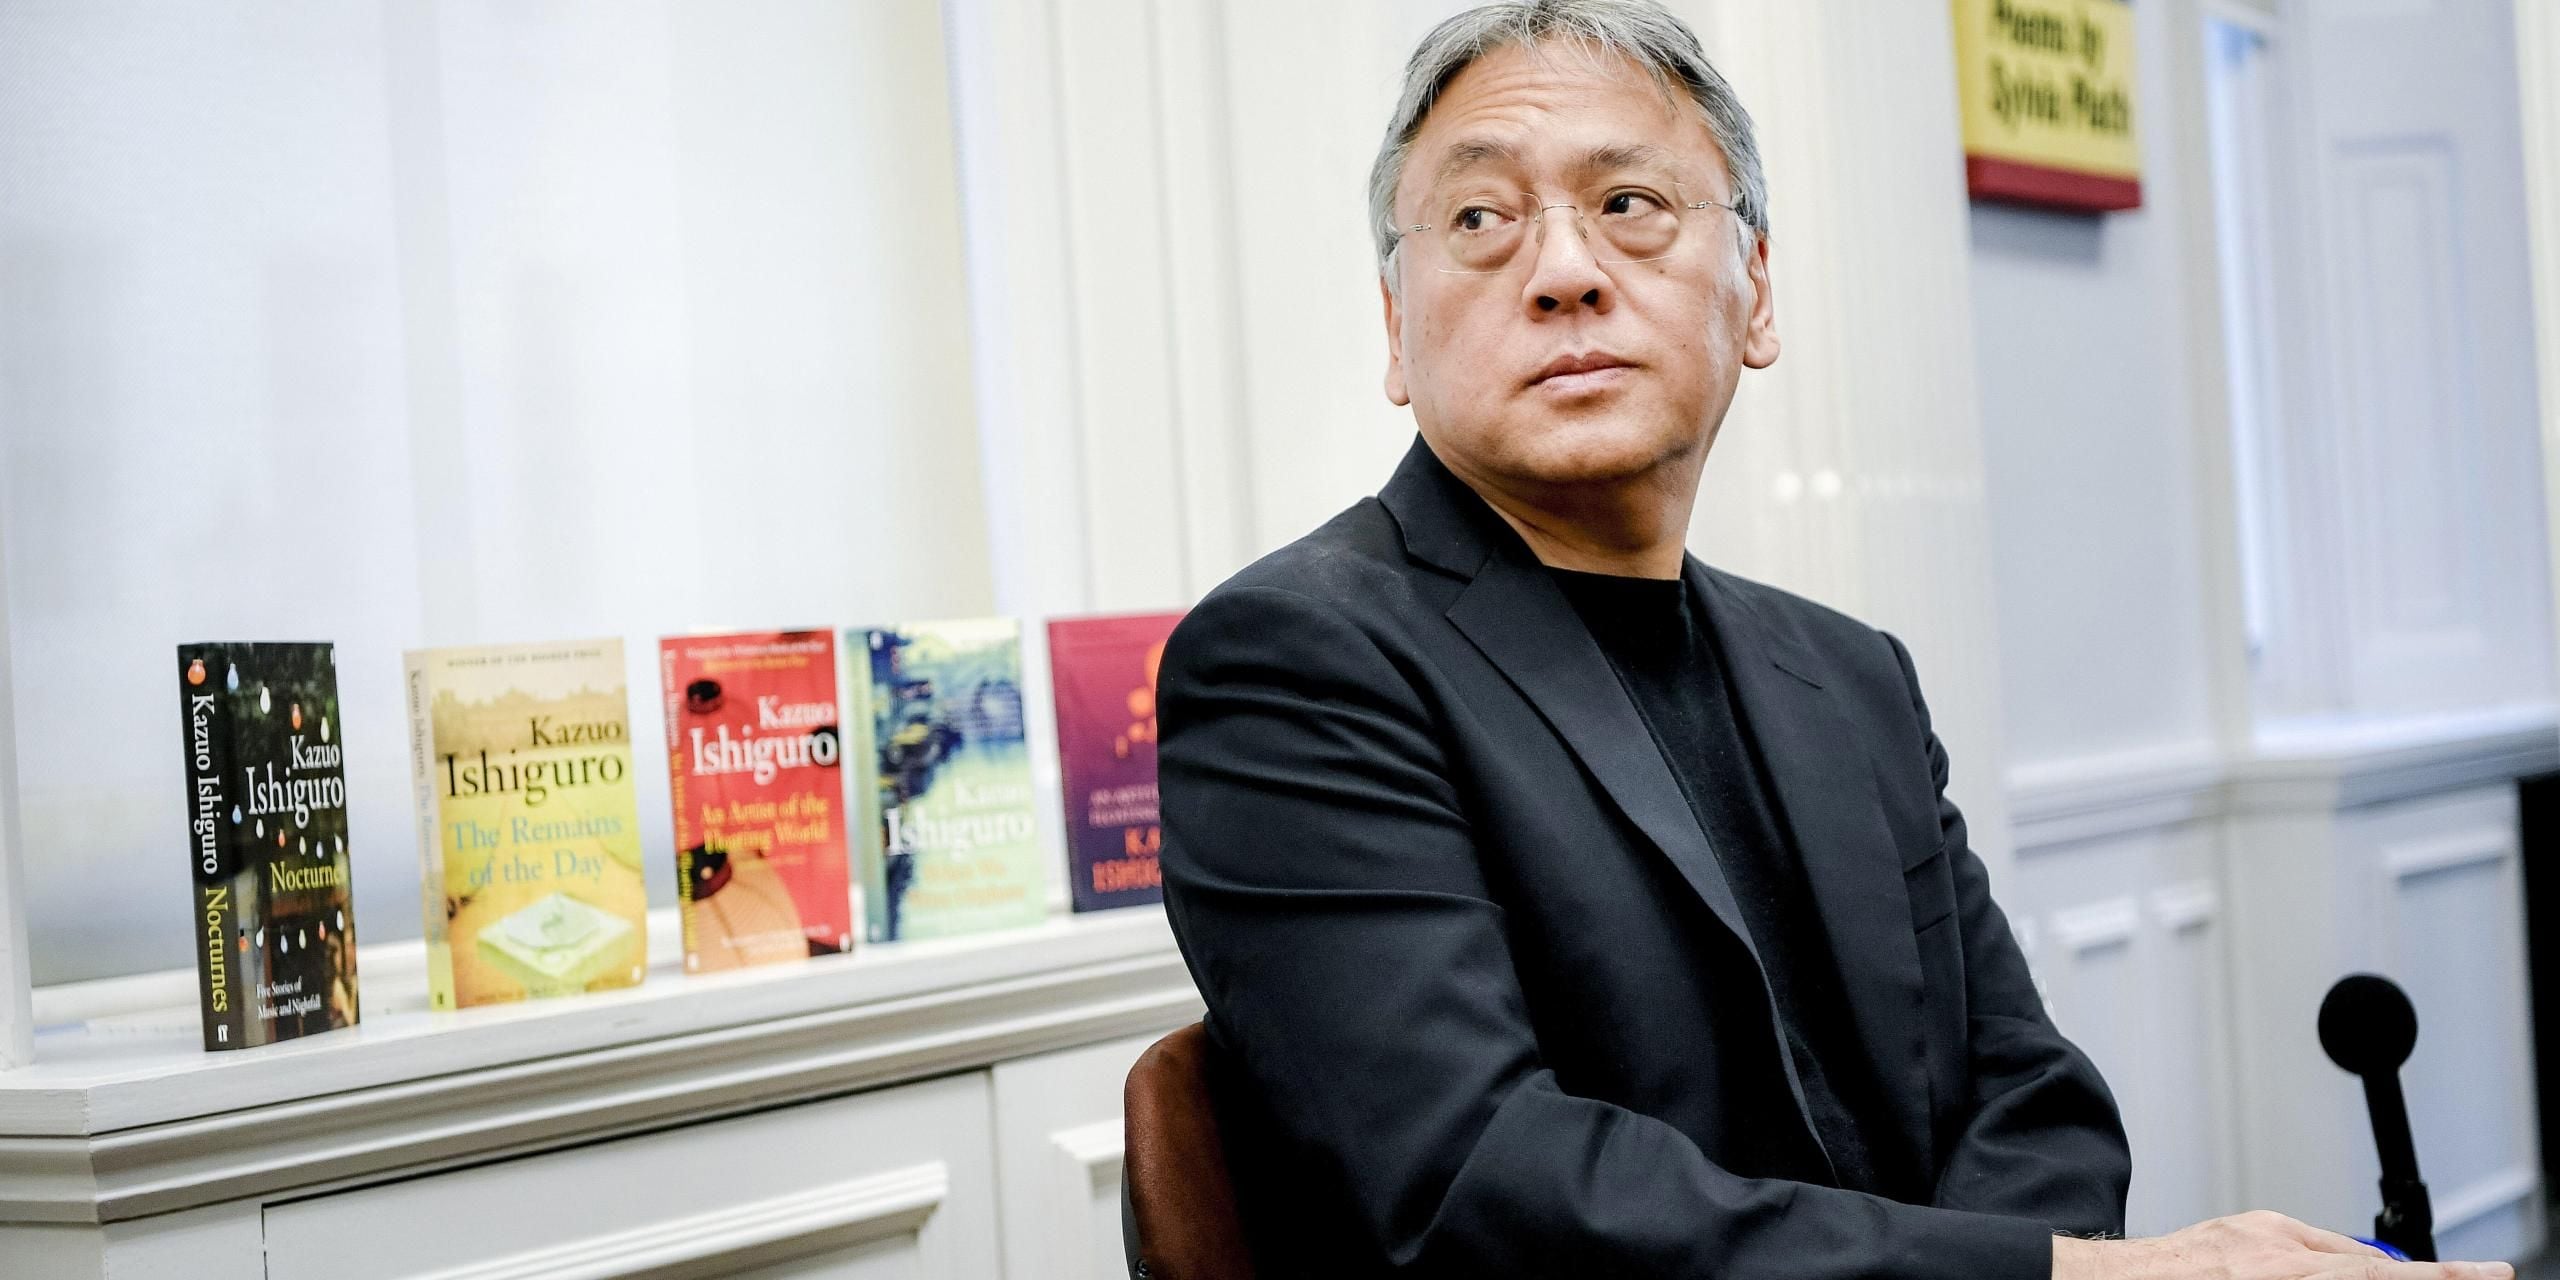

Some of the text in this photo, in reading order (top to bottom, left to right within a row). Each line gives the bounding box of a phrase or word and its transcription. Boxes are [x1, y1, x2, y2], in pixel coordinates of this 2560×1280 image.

[758, 694, 835, 729] Kazuo
[529, 716, 621, 748] Kazuo
[290, 735, 341, 770] Kazuo
[689, 724, 838, 785] Ishiguro
[246, 762, 344, 828] Ishiguro
[445, 746, 624, 807] Ishiguro
[449, 811, 623, 853] The Remains
[884, 806, 1035, 863] Ishiguro
[191, 693, 229, 1013] Kazuo Ishiguro Nocturnes
[468, 849, 606, 887] of the Day
[269, 861, 348, 893] Nocturne
[256, 975, 303, 999] Five Stories of
[257, 993, 321, 1020] Music and Nightfall
